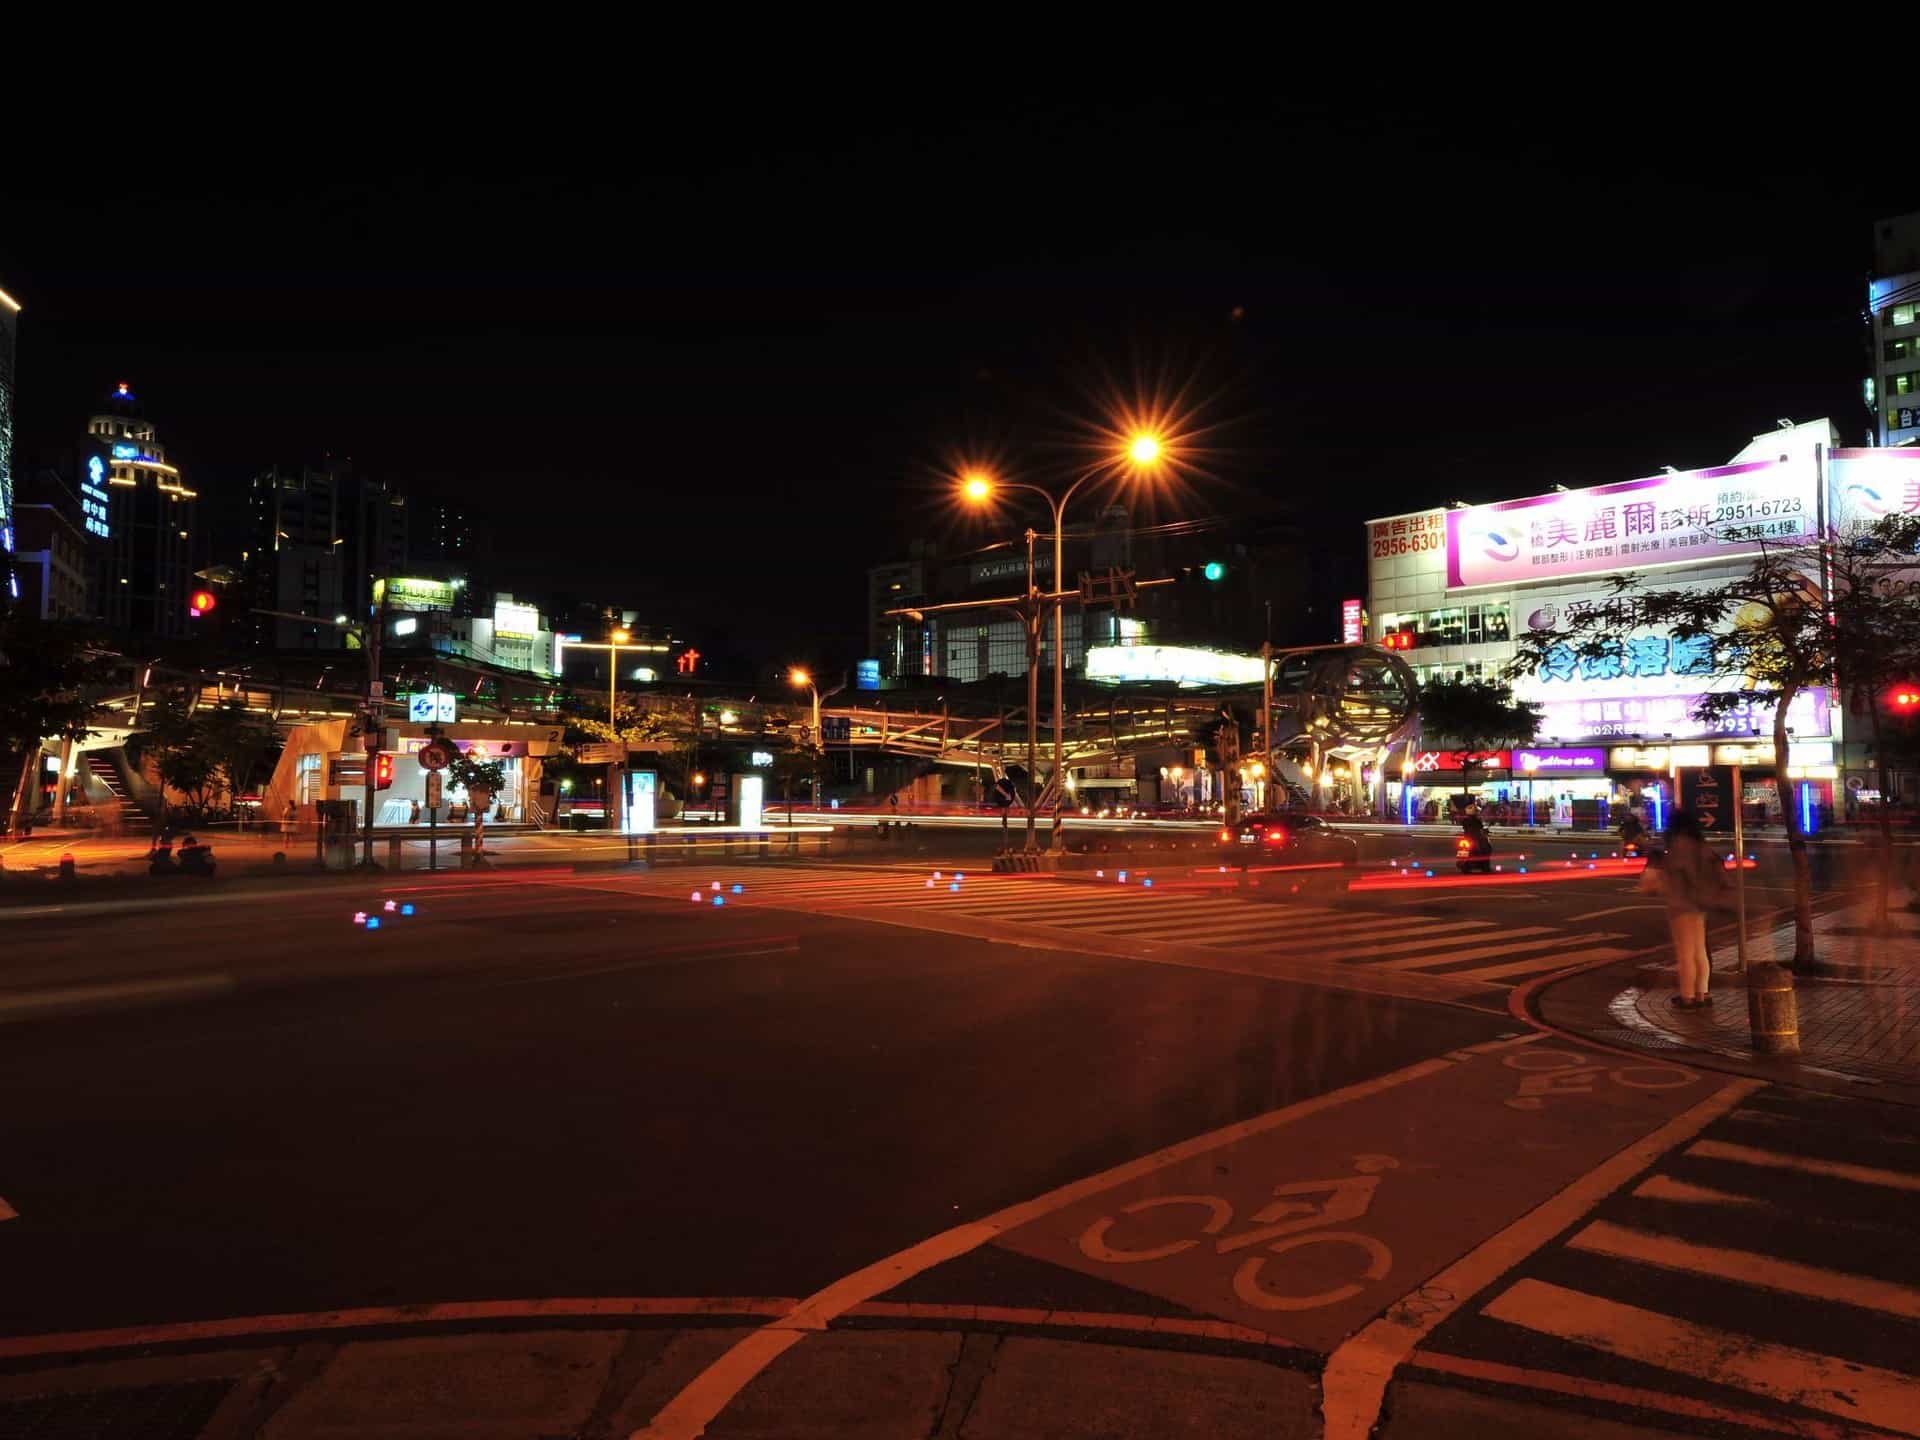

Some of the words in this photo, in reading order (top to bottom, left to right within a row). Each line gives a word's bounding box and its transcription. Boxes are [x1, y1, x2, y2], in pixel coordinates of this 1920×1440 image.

[1717, 498, 1802, 522] 2951-6723
[1374, 514, 1443, 538] 廣告出租
[1547, 501, 1712, 548] 美麗爾診所
[1374, 531, 1445, 557] 2956-6301
[549, 731, 558, 742] 2
